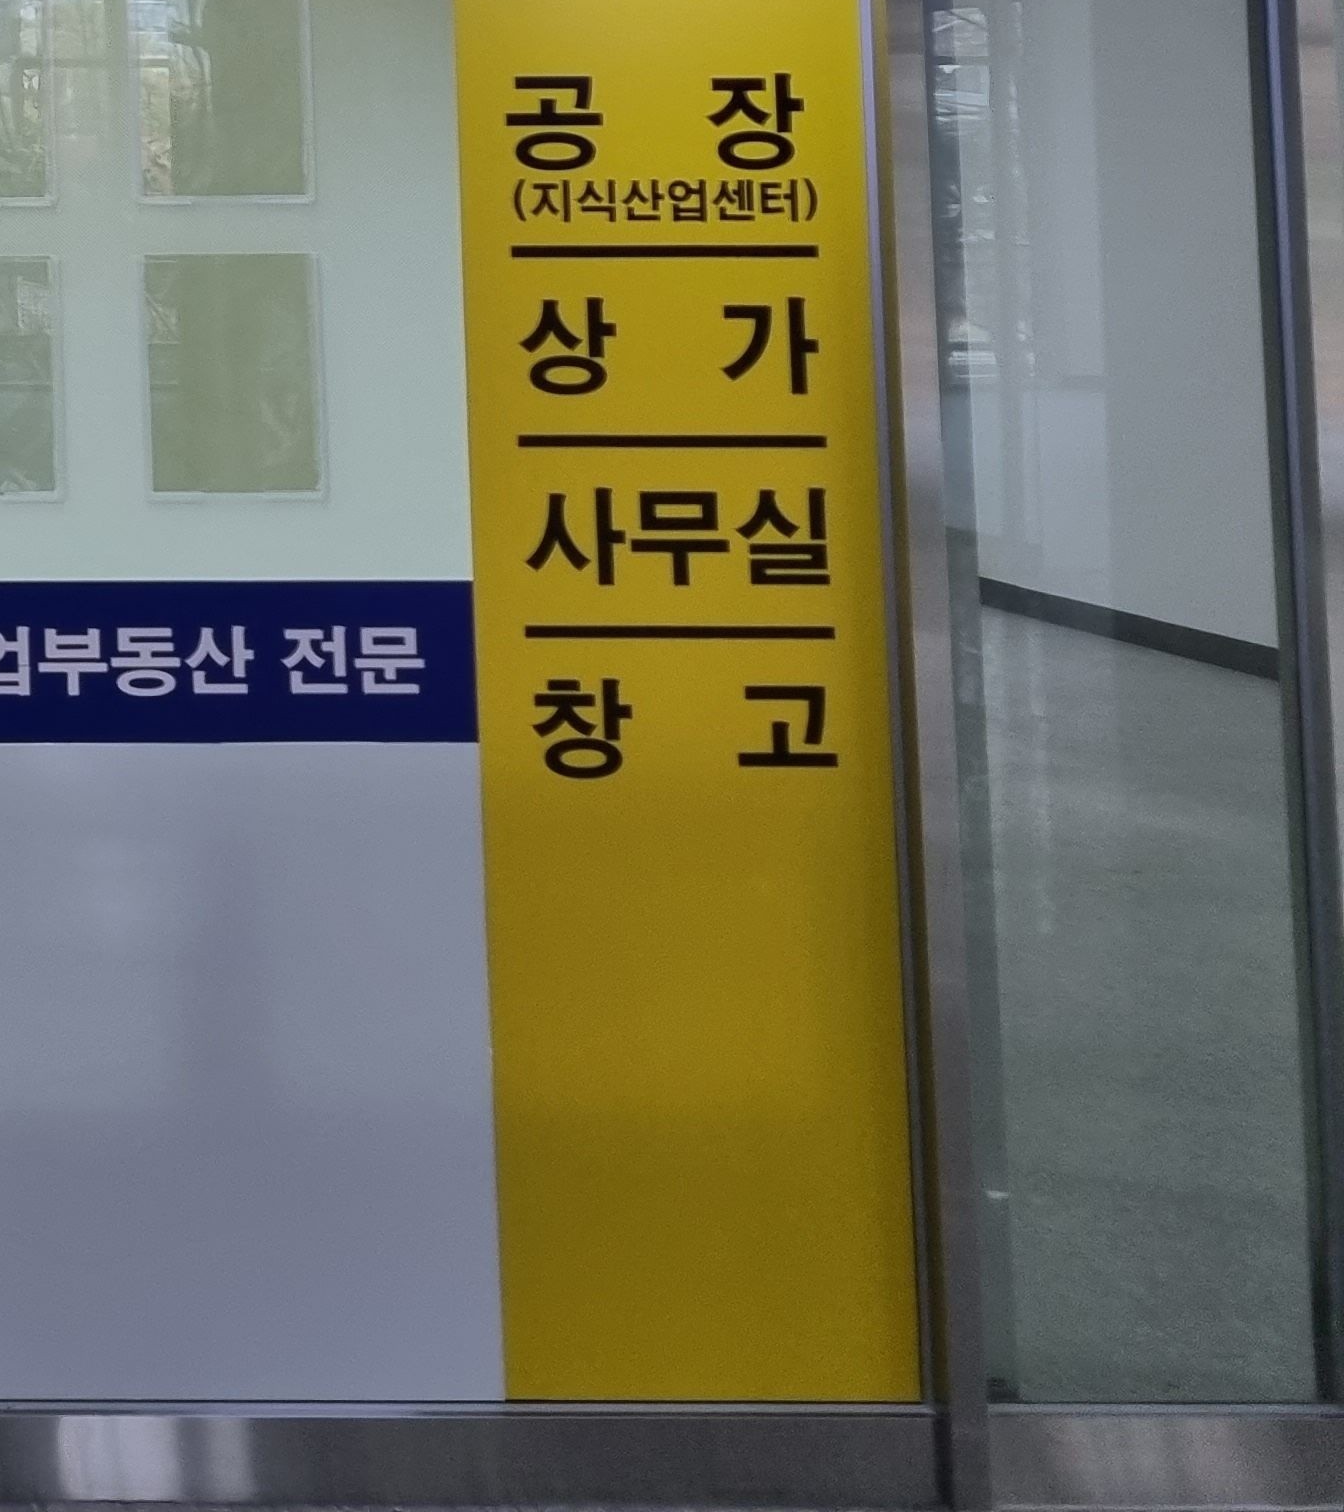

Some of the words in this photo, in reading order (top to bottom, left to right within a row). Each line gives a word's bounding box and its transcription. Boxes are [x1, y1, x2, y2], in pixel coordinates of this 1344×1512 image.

[513, 178, 819, 224] (지식산업센터)
[525, 486, 832, 588] 사무실
[281, 624, 426, 696] 전문
